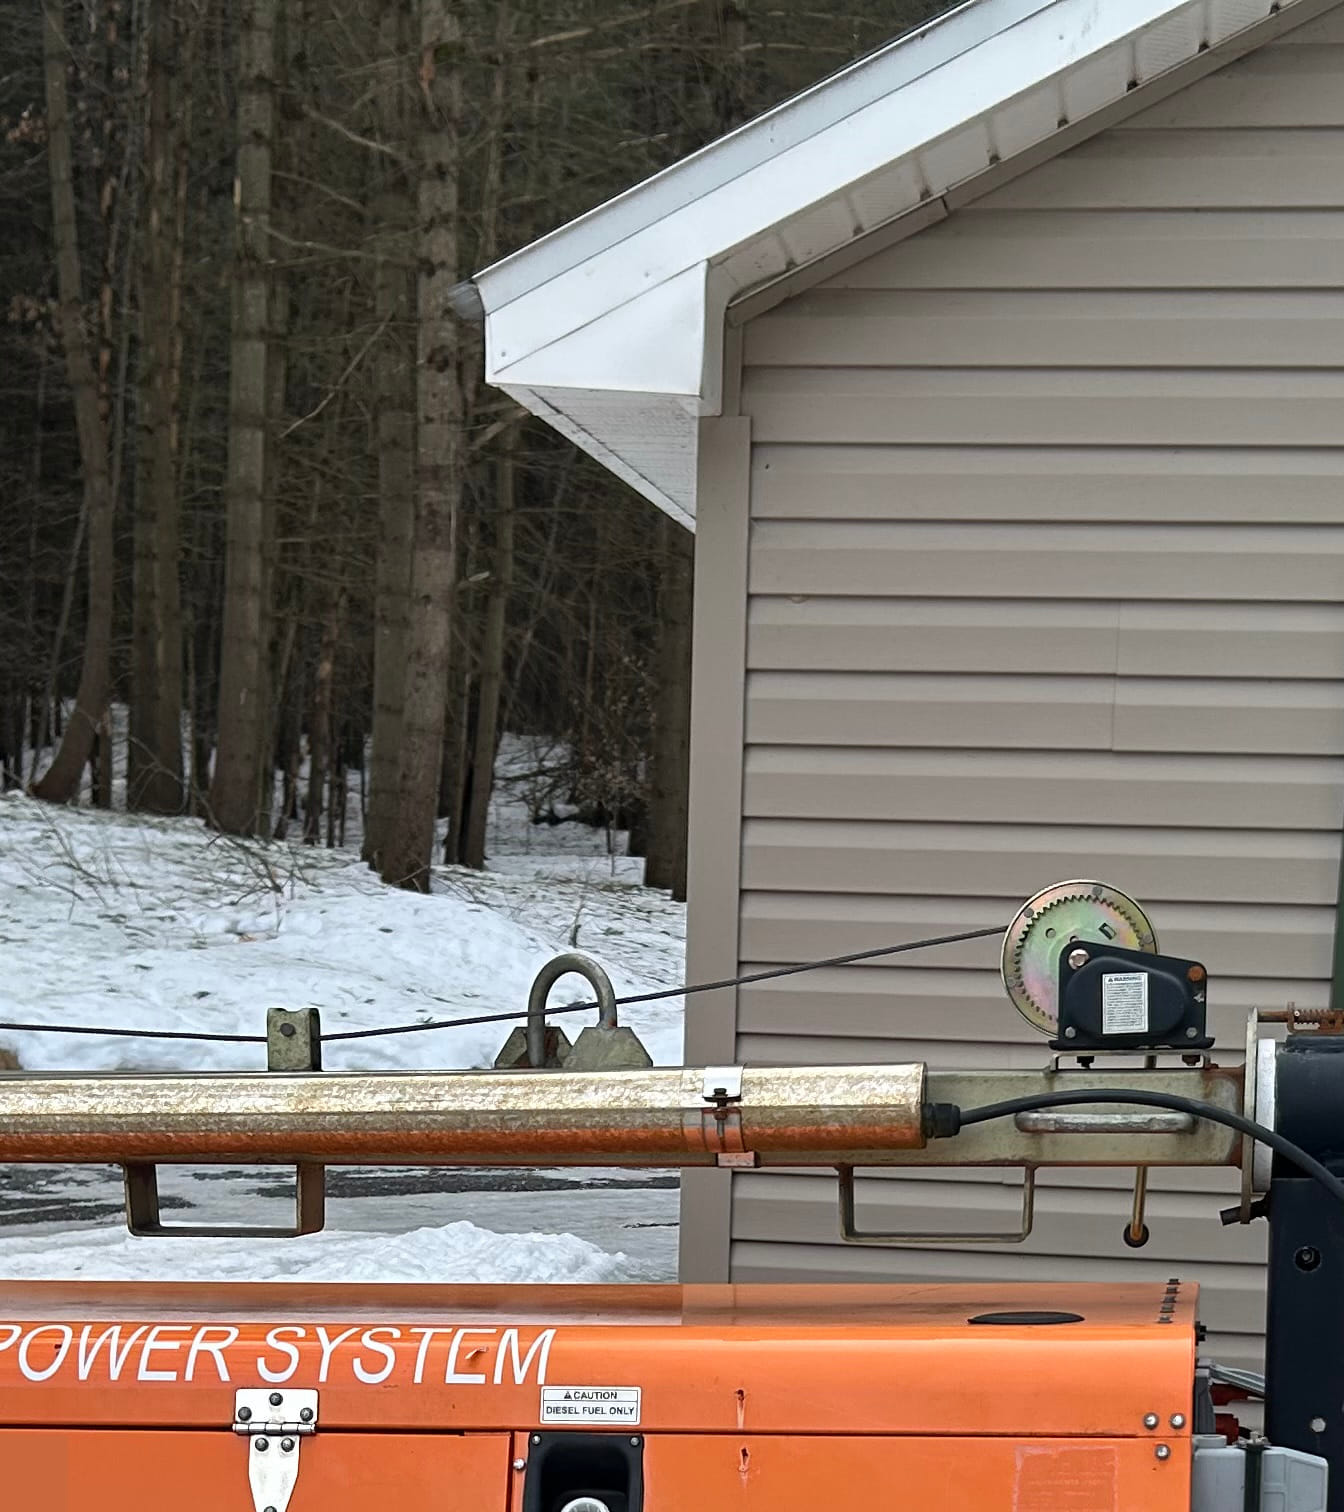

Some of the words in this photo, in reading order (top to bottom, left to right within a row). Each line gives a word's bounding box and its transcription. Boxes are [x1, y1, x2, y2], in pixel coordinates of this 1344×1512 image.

[256, 1326, 557, 1385] SYSTEM
[573, 1391, 618, 1400] CAUTION
[546, 1406, 580, 1415] DIESEL
[582, 1406, 607, 1415] FUEL
[609, 1406, 635, 1415] ONLY
